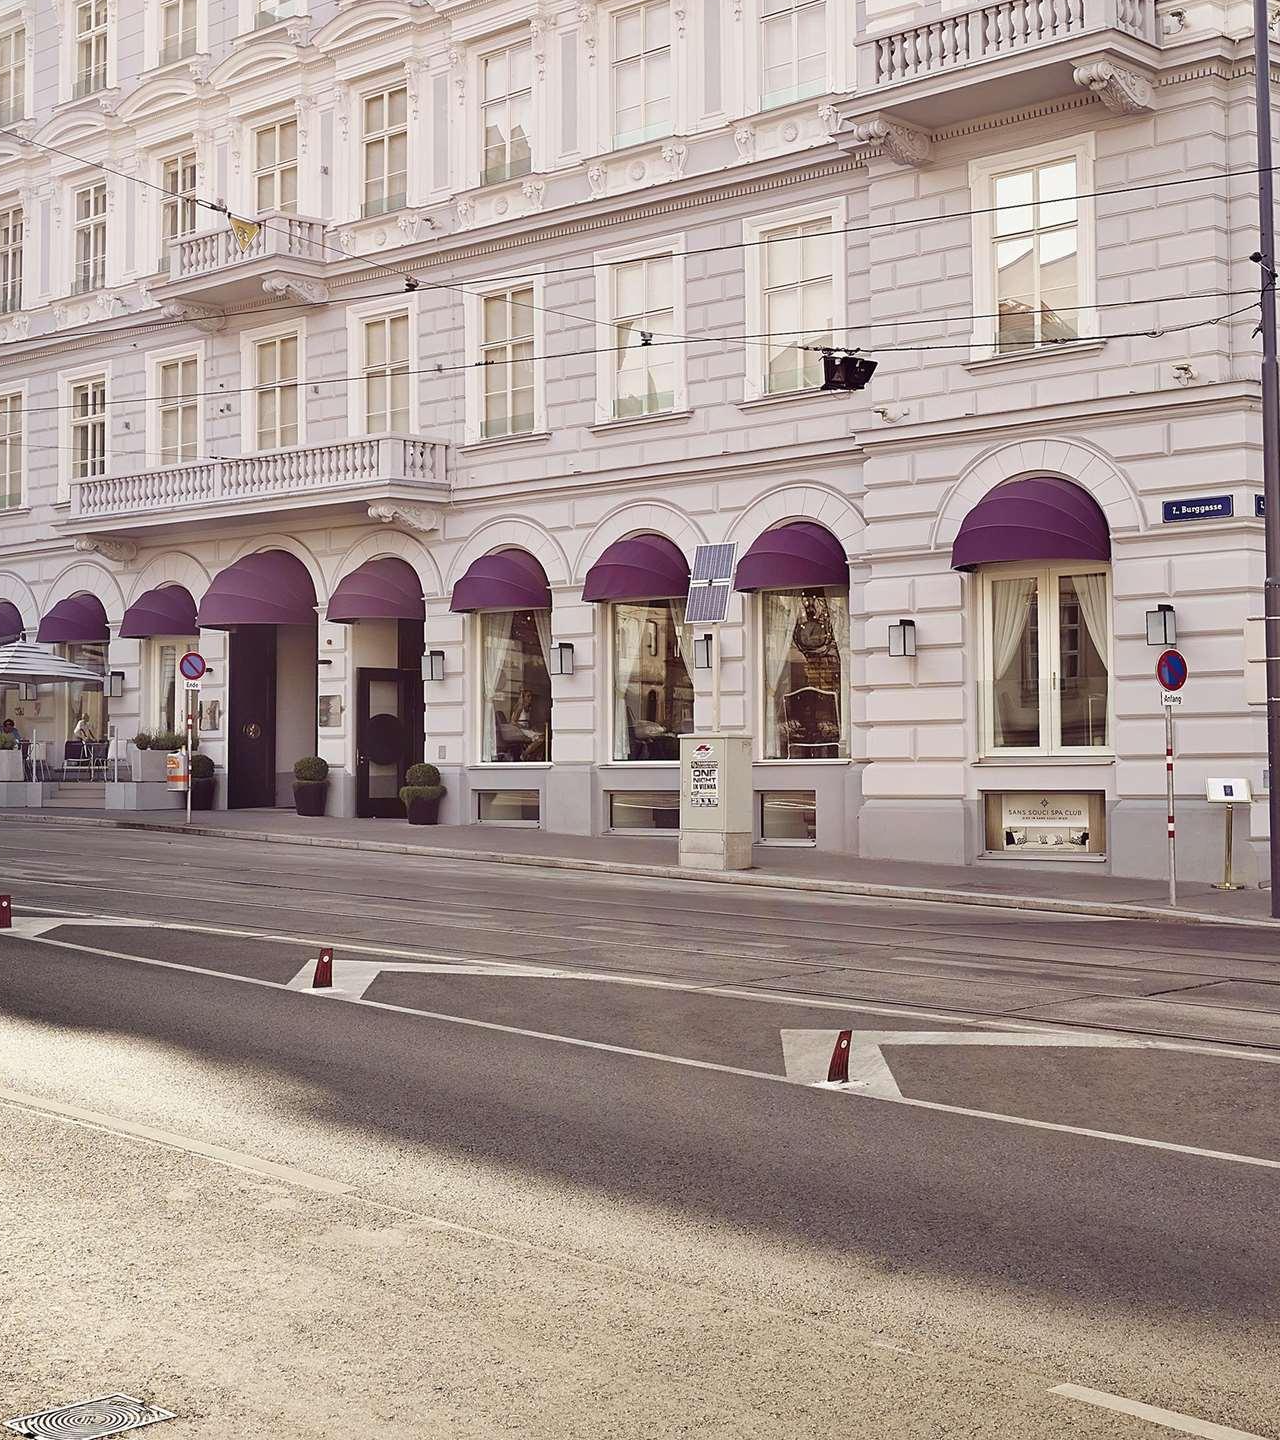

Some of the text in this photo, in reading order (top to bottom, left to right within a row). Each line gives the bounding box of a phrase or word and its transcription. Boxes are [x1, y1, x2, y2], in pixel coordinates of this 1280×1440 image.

[1181, 504, 1223, 514] Burggasse
[186, 680, 199, 688] Ende
[1163, 694, 1182, 704] Anfang
